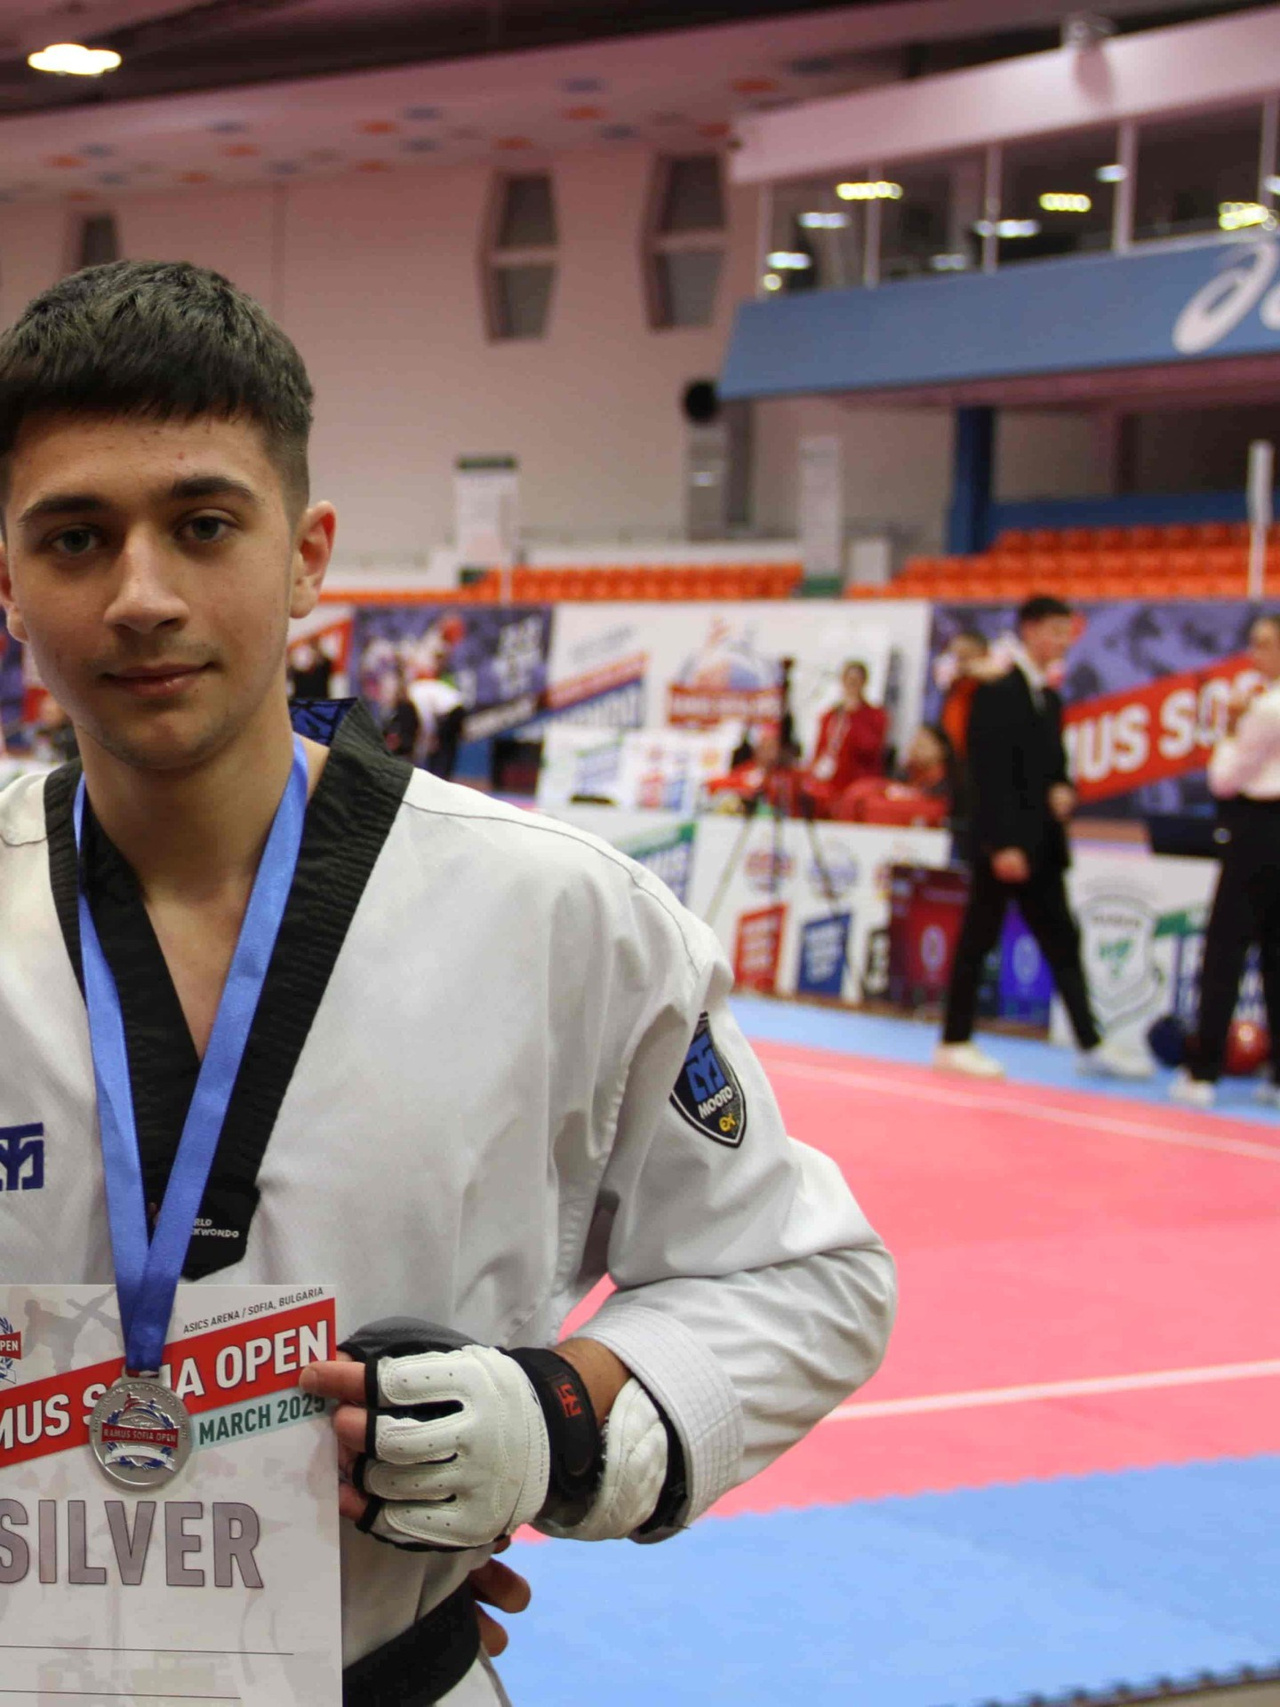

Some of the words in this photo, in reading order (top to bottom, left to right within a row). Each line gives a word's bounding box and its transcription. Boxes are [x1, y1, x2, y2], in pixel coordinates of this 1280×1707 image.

[1063, 703, 1150, 782] US
[698, 1085, 734, 1119] MOOTO
[192, 1228, 240, 1238] KWONDO
[183, 1318, 210, 1334] ASICS
[210, 1310, 240, 1326] ARENA
[278, 1287, 324, 1307] BULGARIA
[215, 1320, 328, 1389] OPEN
[199, 1404, 271, 1446] MARCH
